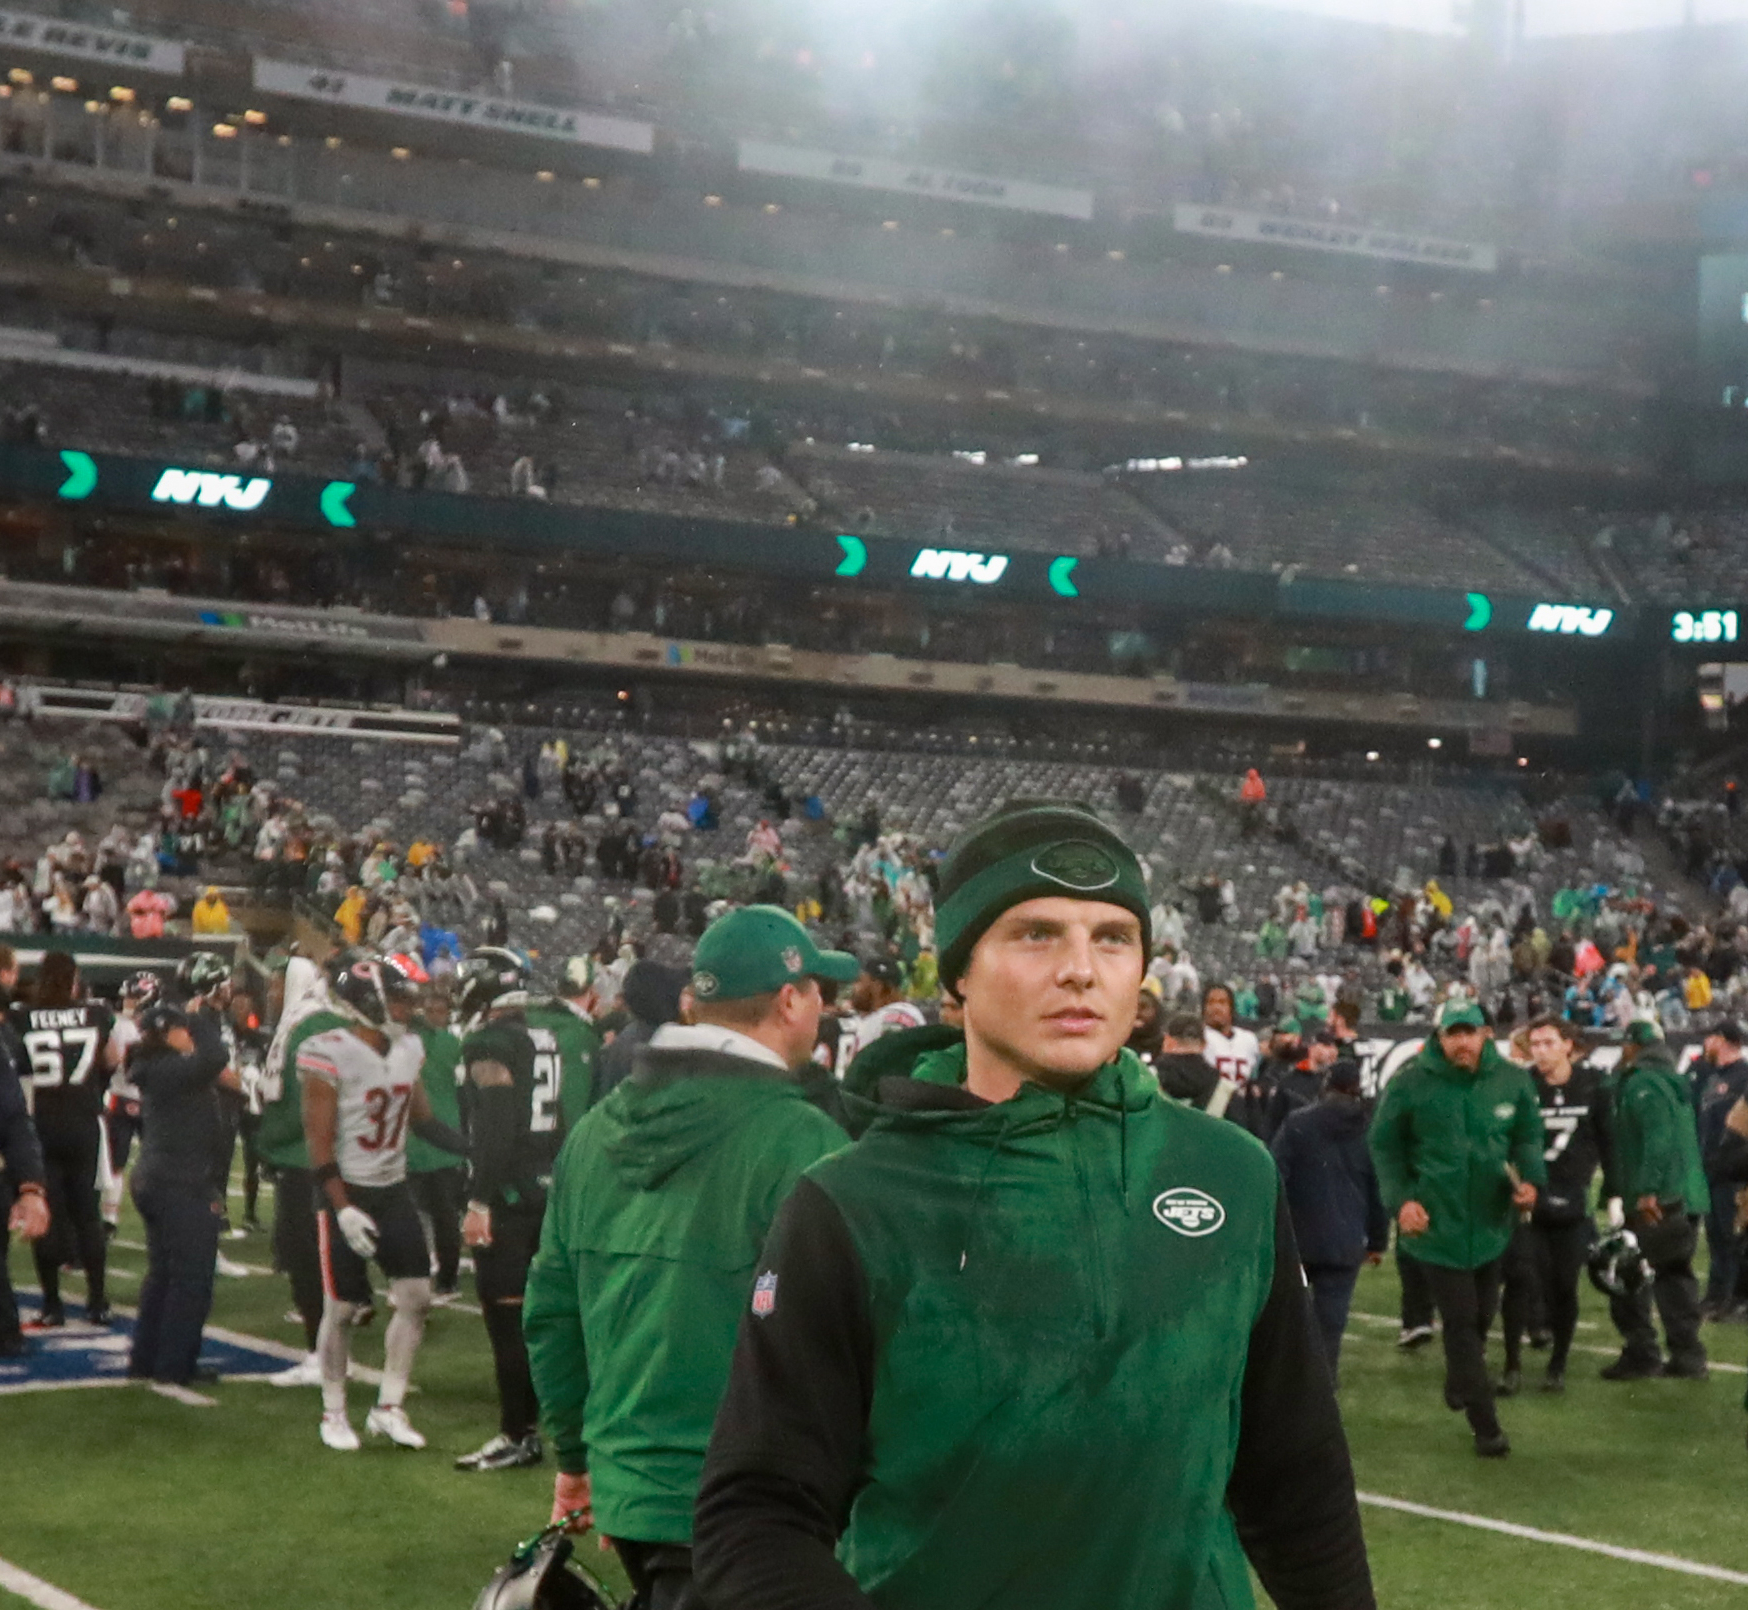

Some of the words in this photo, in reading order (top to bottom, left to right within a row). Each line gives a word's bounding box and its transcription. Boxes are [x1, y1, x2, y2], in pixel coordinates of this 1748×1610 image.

[386, 88, 474, 115] MATT
[484, 104, 576, 133] SNELL
[151, 467, 272, 511] NYJ
[910, 548, 1009, 584] NYJ
[1527, 602, 1613, 637] NYJ
[1672, 609, 1739, 643] 3:51
[29, 1006, 88, 1030] FEENEY
[22, 1026, 99, 1088] 67
[356, 1082, 412, 1152] 37
